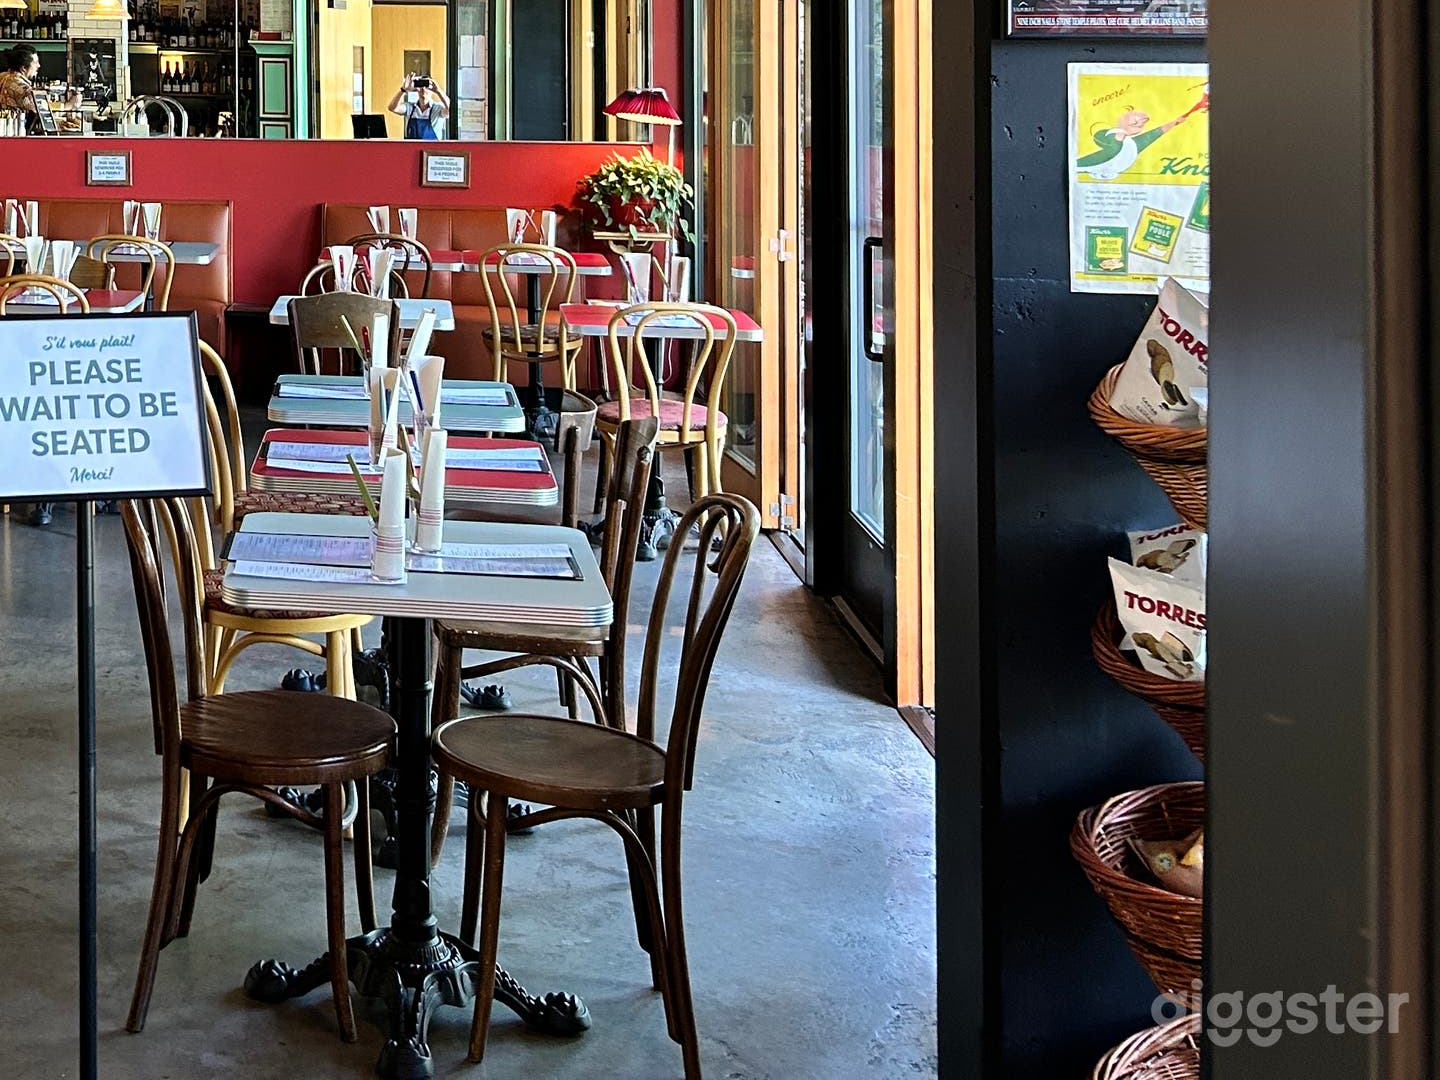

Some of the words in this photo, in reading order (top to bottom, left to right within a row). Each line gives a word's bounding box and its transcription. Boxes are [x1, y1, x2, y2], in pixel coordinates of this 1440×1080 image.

[42, 336, 66, 351] S'il
[69, 340, 96, 350] vous
[29, 358, 142, 386] PLEASE
[87, 393, 131, 419] TO
[139, 391, 178, 418] BE
[31, 428, 150, 457] SEATED
[70, 467, 114, 483] Merci!
